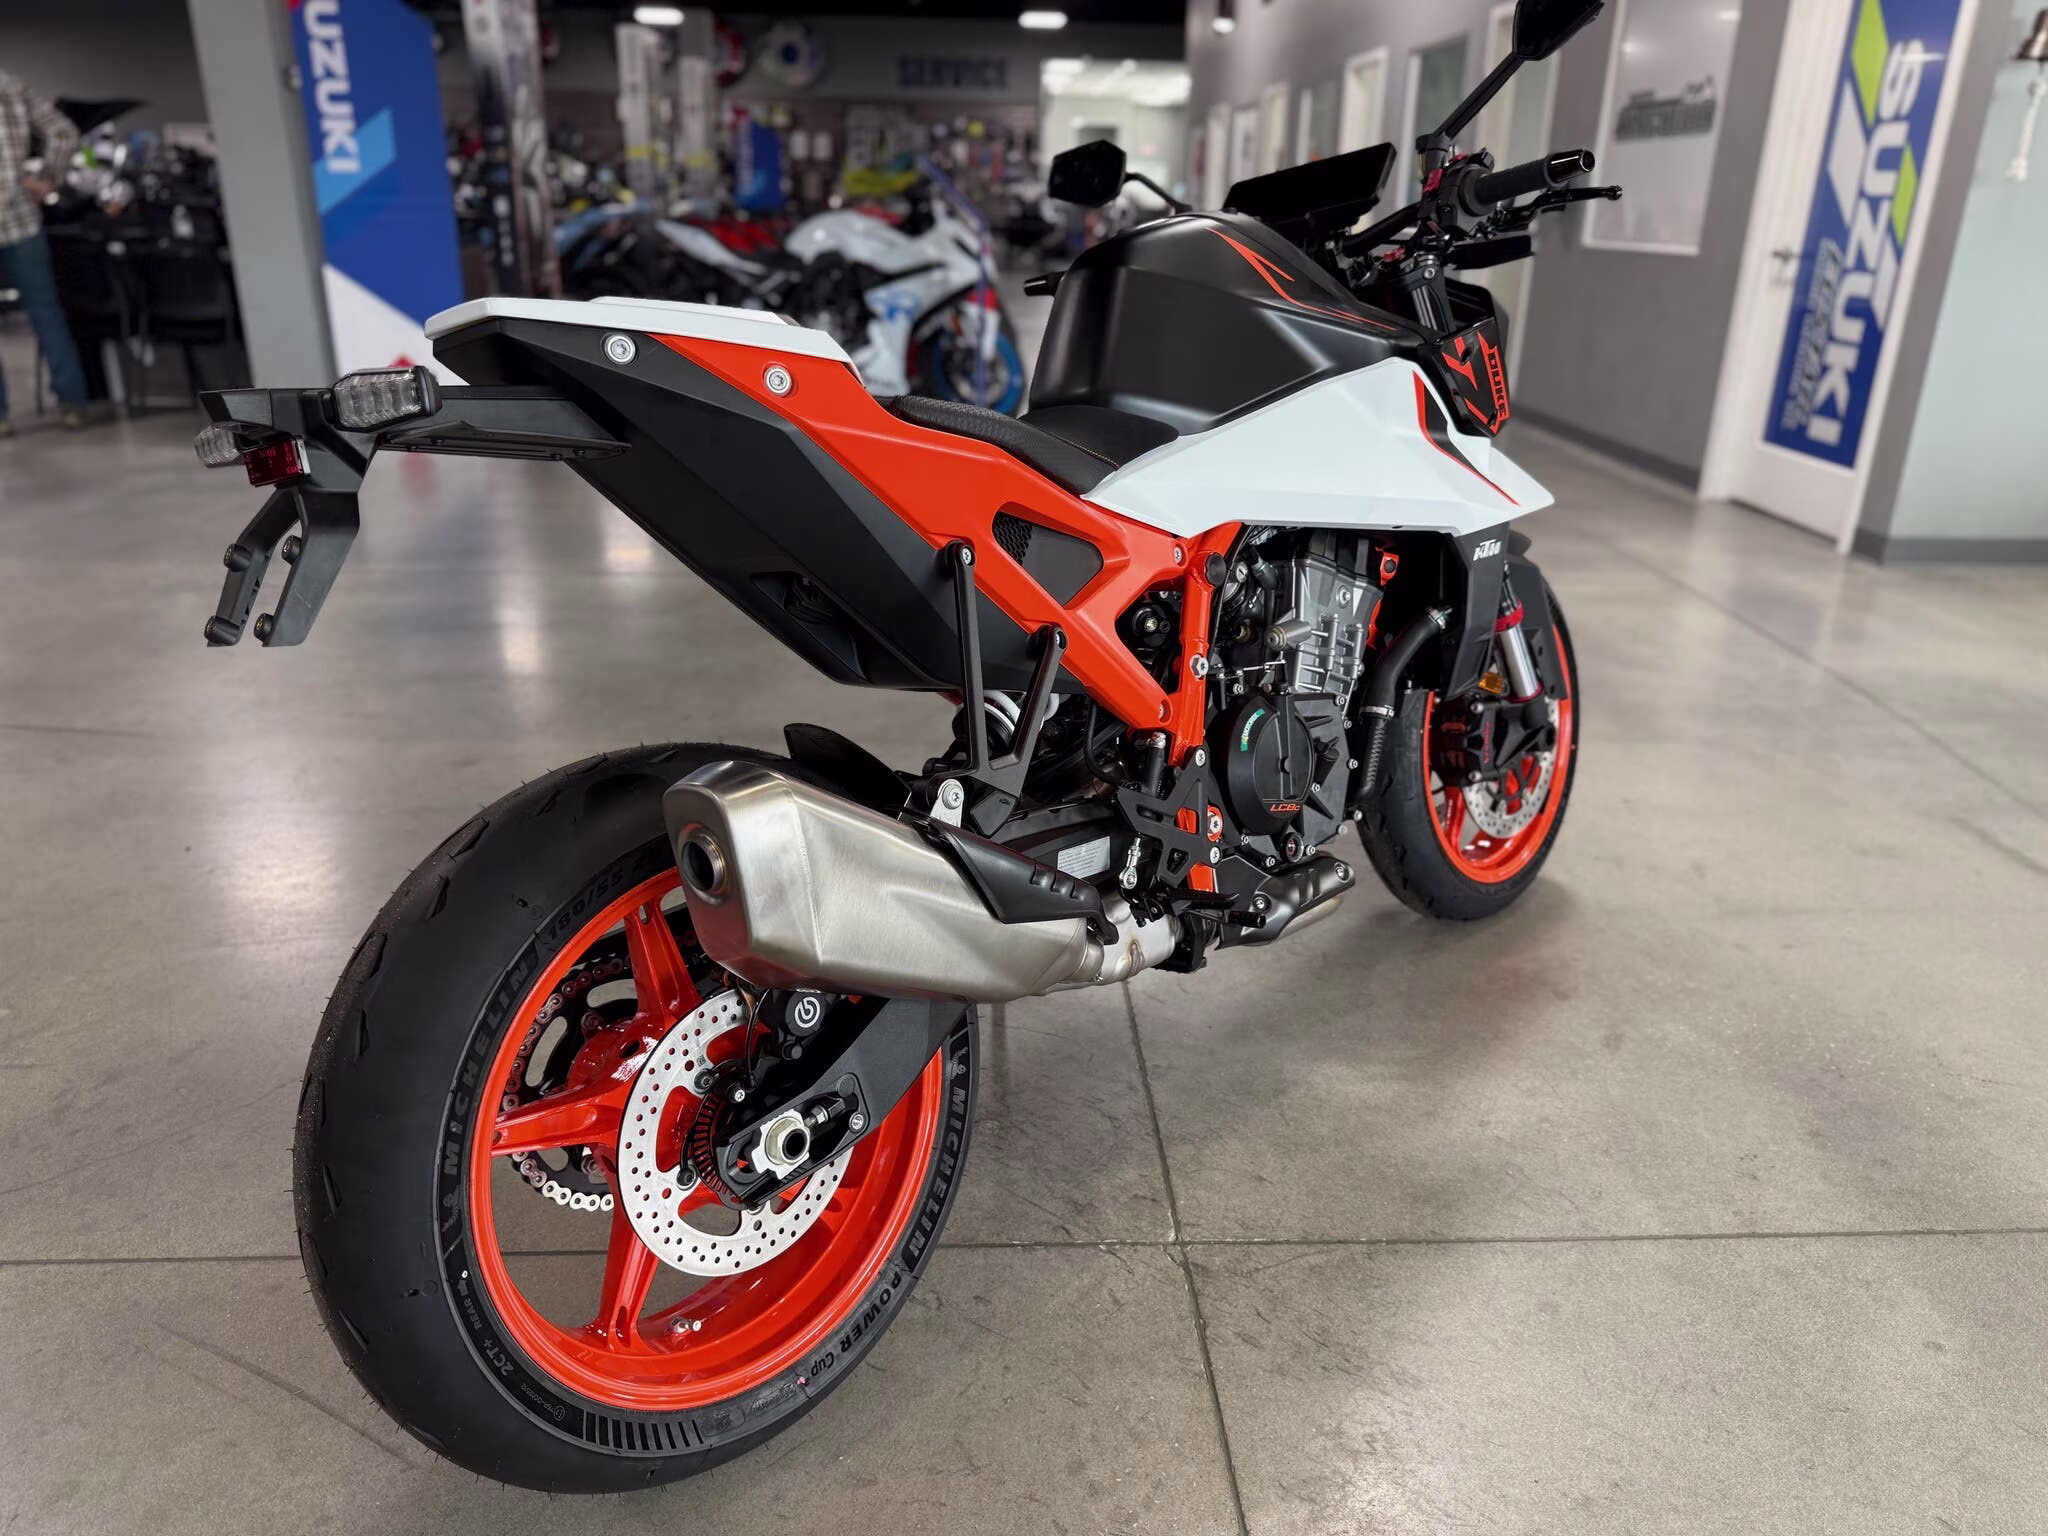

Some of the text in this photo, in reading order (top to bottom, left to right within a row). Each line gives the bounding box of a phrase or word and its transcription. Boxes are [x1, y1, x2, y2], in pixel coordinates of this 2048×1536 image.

[1805, 38, 1924, 447] SUZUKI
[1487, 353, 1507, 419] DUKE
[1473, 539, 1502, 561] KTM
[444, 960, 530, 1176] MICHELIN
[909, 1086, 966, 1257] MICHELIN
[463, 1298, 515, 1376] 2CT+ REAR
[811, 1271, 902, 1377] POWER Cup
